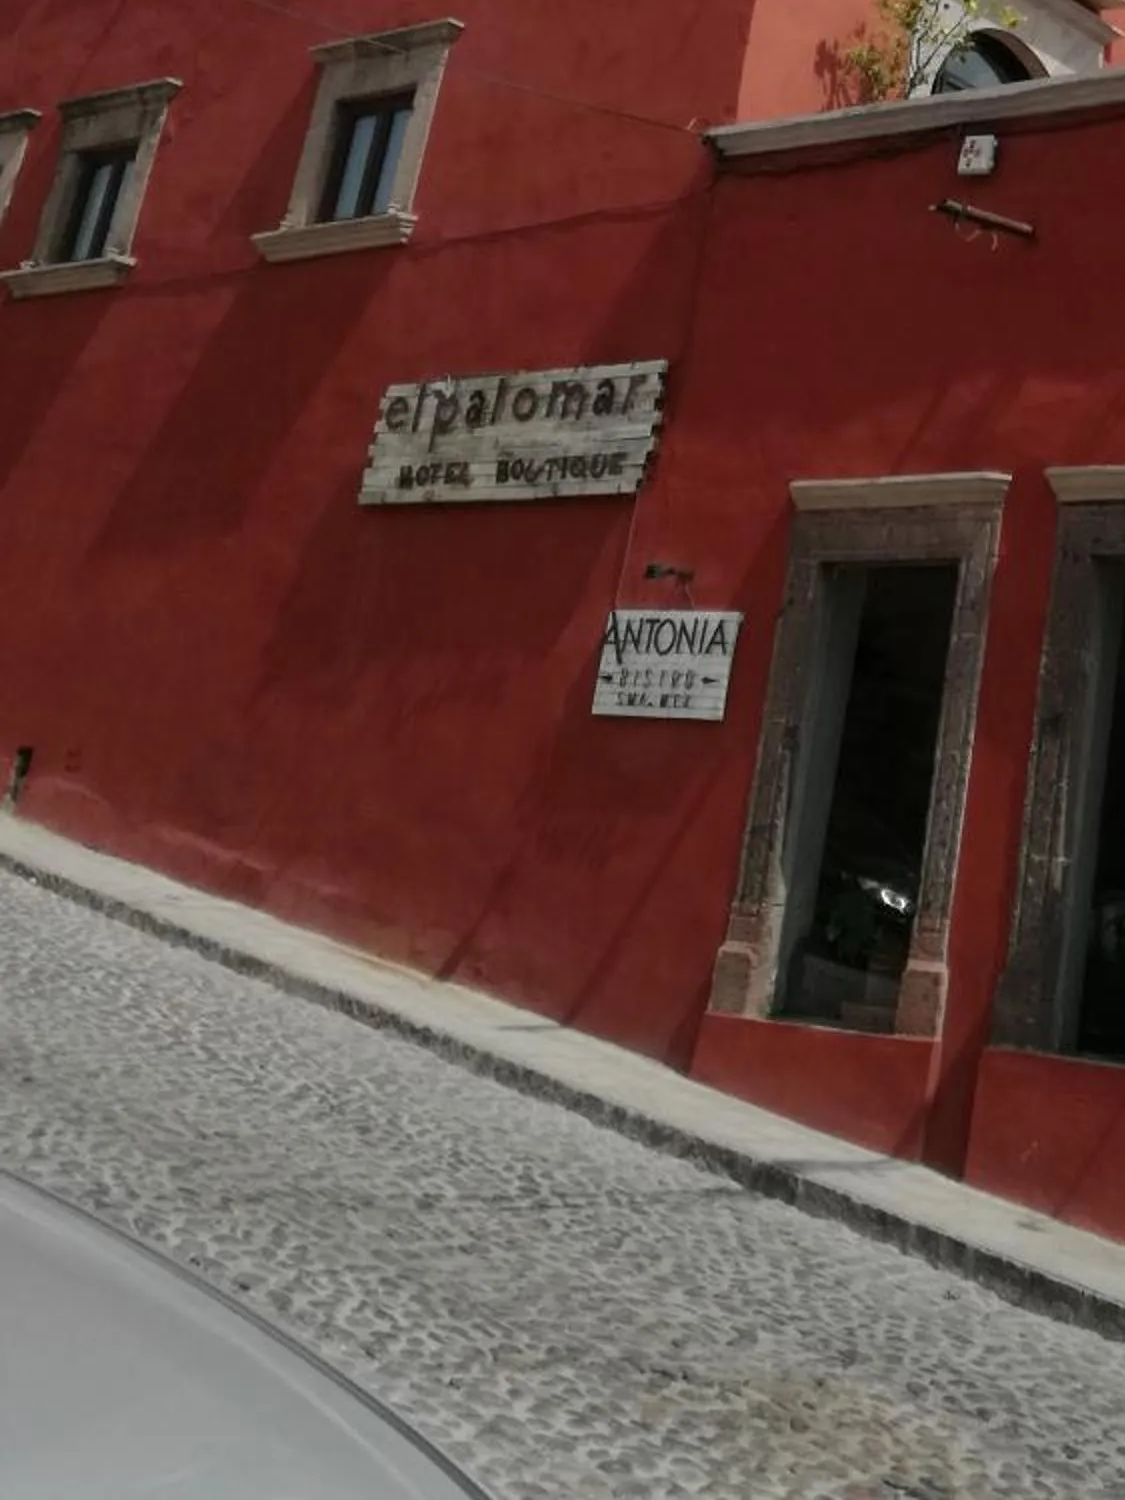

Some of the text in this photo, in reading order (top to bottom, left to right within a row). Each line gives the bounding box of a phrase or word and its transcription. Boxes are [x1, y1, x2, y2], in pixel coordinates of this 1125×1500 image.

[384, 376, 646, 453] el palomar
[396, 451, 628, 490] HOTEL BOUTIQUE
[603, 611, 728, 664] ANTONIA
